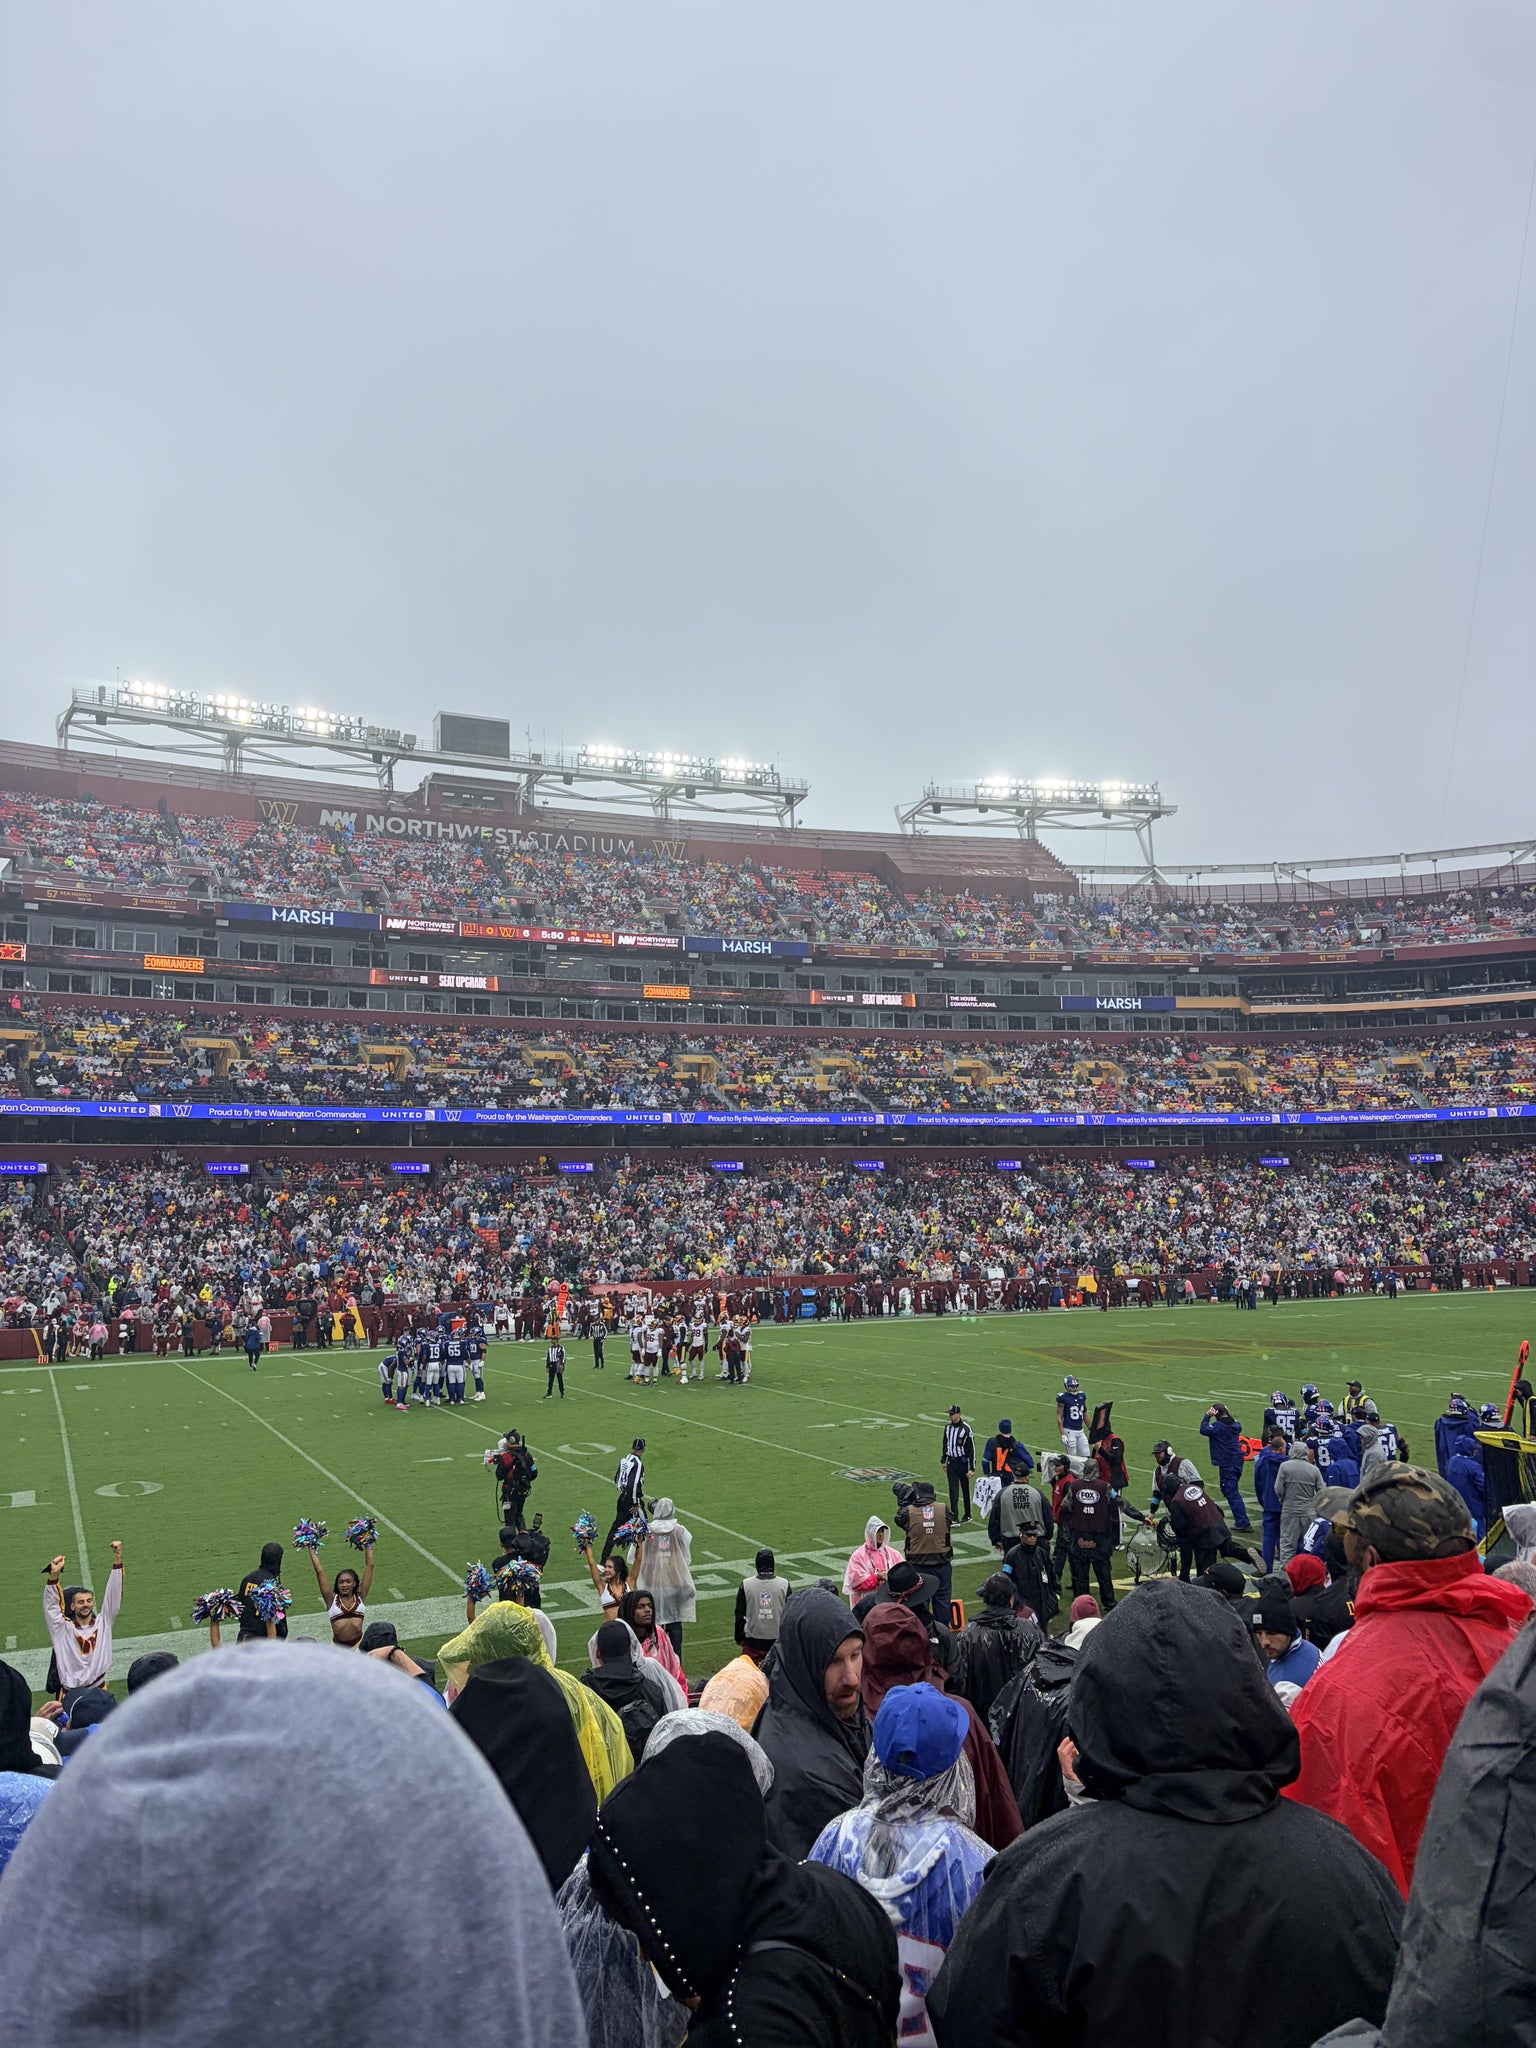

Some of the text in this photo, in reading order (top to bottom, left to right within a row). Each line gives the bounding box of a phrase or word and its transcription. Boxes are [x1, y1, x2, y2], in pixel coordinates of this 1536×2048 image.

[527, 831, 635, 855] STADIUM
[46, 889, 57, 898] 57
[272, 907, 335, 926] MARSH
[407, 920, 456, 929] NORTHWEST
[522, 929, 530, 937] 6
[541, 931, 564, 939] 5:50
[722, 940, 771, 954] MARSH
[144, 957, 205, 971] COMMANDERS
[439, 975, 487, 989] SEAT UPGRADE
[643, 987, 690, 997] COMMANDERS
[862, 994, 902, 1005] SEAT UPGRADE
[1097, 998, 1142, 1009] MARSH
[20, 1103, 80, 1113] Commanders
[100, 1106, 146, 1114] UNITED
[209, 1108, 233, 1116] Proud
[244, 1108, 254, 1119] fly
[255, 1109, 267, 1117] the
[269, 1110, 314, 1119] Washington
[315, 1110, 367, 1119] Commanders
[382, 1111, 423, 1119] UNITED
[476, 1112, 496, 1120] Proud
[506, 1113, 514, 1121] fly
[515, 1113, 527, 1121] the
[528, 1114, 567, 1122] Washington
[734, 1115, 742, 1123] fly
[754, 1115, 789, 1124] Washington
[1359, 1114, 1394, 1122] Washington
[430, 1346, 440, 1359] 19
[448, 1345, 461, 1357] 65
[1070, 1406, 1084, 1420] 84
[1276, 1416, 1295, 1435] 85
[1378, 1434, 1397, 1457] 64
[1318, 1446, 1334, 1466] 8
[1081, 1491, 1095, 1499] FOX
[1187, 1488, 1197, 1496] FOX
